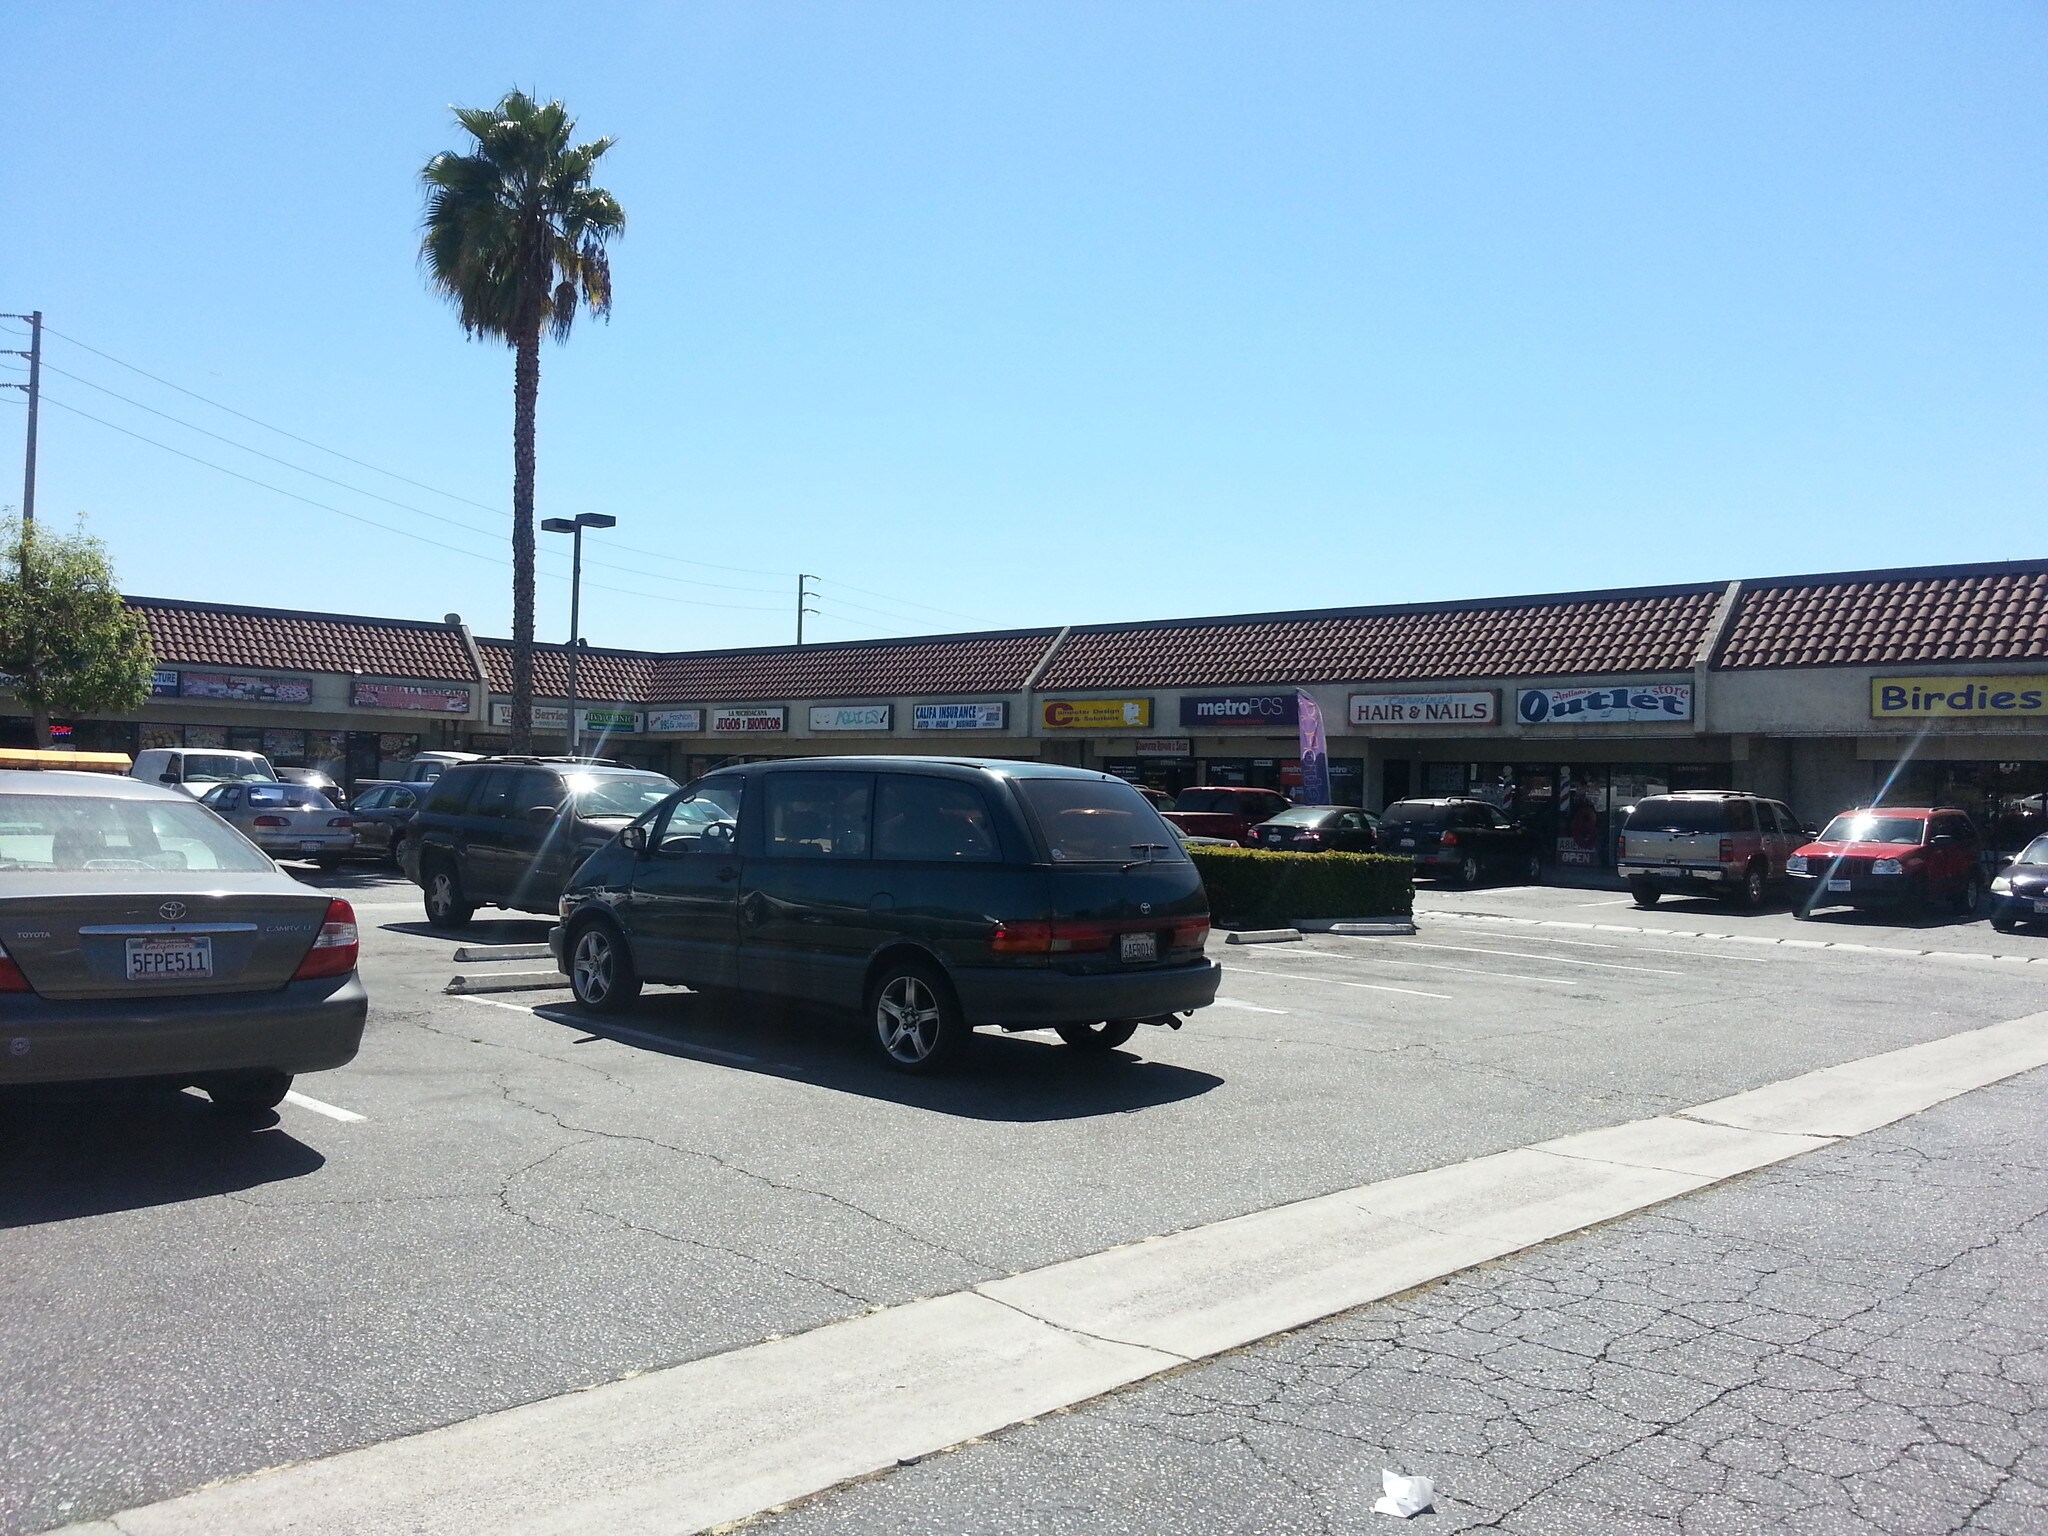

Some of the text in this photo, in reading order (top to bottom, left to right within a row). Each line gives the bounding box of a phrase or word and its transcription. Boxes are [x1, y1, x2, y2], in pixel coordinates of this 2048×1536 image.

[1652, 685, 1689, 699] store
[1882, 684, 2042, 711] Birdies
[915, 705, 977, 719] CALIFA INSURANCE
[1197, 697, 1283, 716] metroPCS
[1357, 703, 1487, 720] HAIR & NAILS
[1520, 688, 1684, 722] Outlet
[669, 712, 692, 721] Fashion
[716, 718, 741, 730] JUGOS
[742, 720, 746, 729] Y
[956, 720, 977, 728] BUSINESS
[1561, 852, 1590, 864] OPEN
[17, 931, 51, 939] TOYOTA
[144, 942, 193, 952] California
[132, 951, 206, 973] 5FPE511
